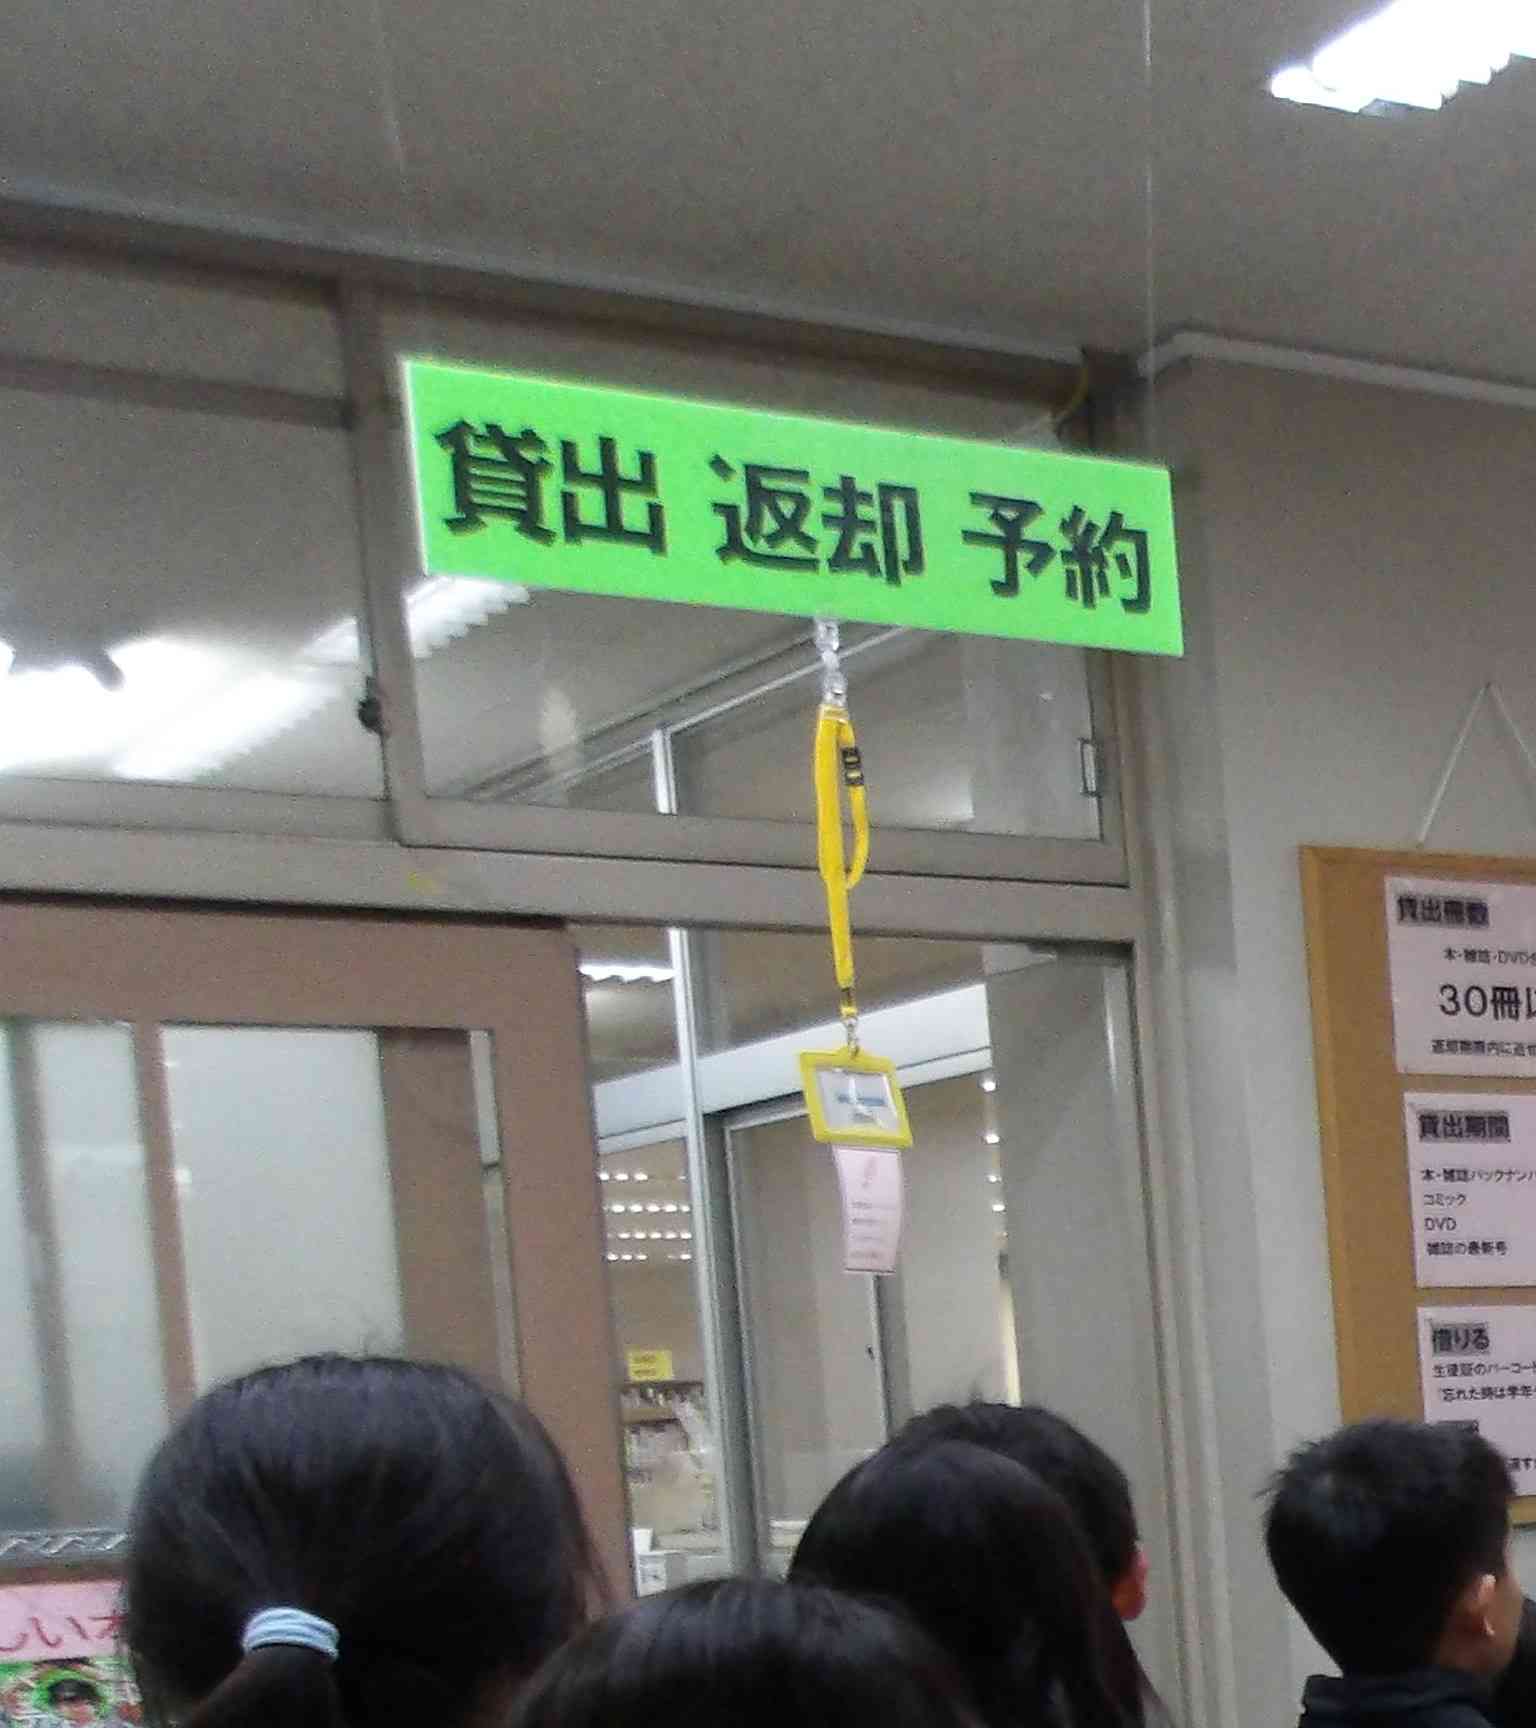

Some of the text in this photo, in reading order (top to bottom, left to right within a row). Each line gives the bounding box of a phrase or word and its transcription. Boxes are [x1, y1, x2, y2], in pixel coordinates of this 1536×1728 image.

[434, 419, 1151, 614] 貸出 返却 予約
[1418, 1111, 1510, 1142] 貸出期間
[1424, 1193, 1467, 1207] コミック
[1424, 1217, 1457, 1231] DVD
[1432, 1324, 1489, 1354] 借りる
